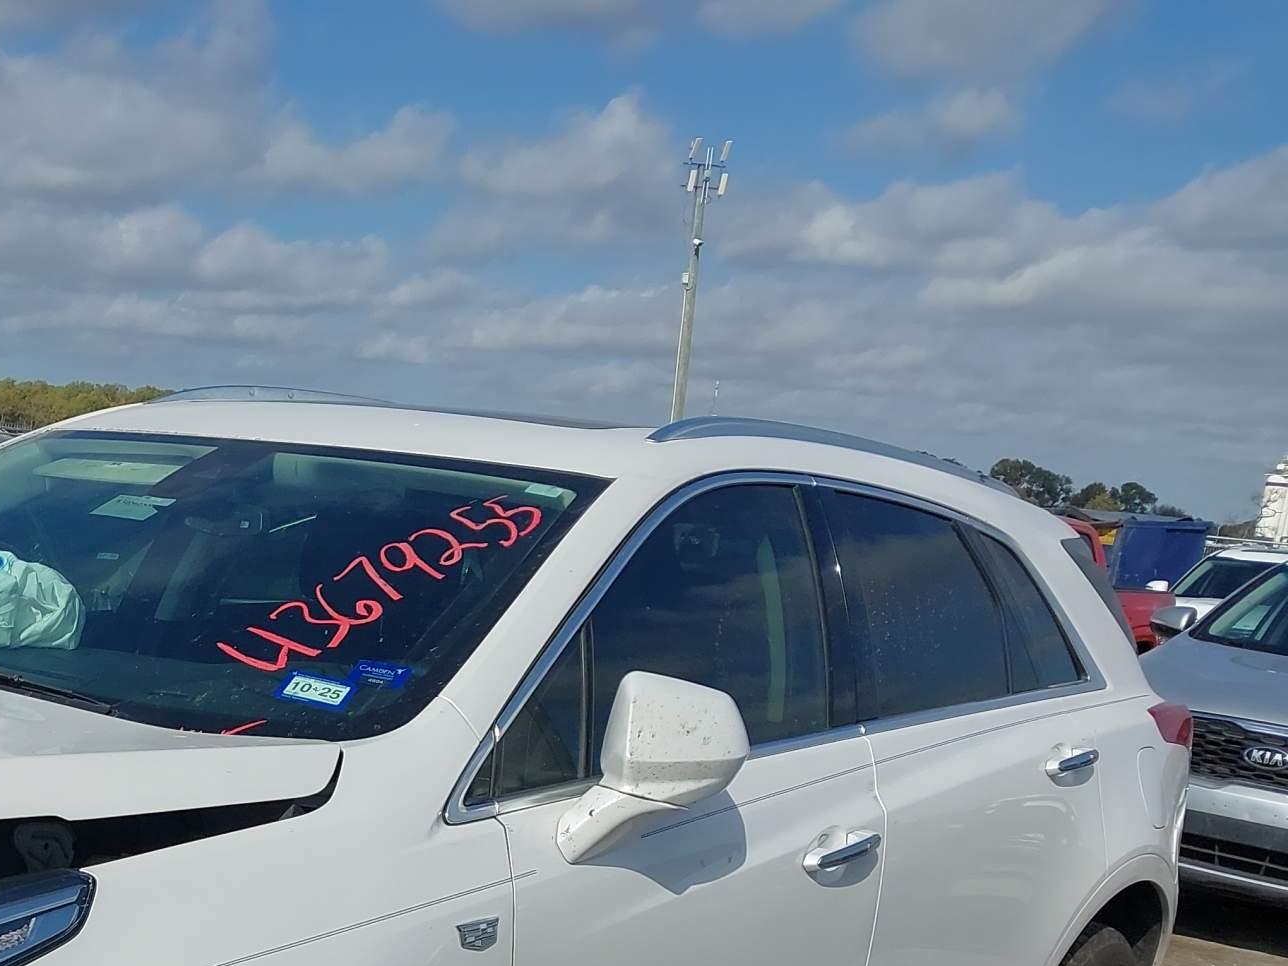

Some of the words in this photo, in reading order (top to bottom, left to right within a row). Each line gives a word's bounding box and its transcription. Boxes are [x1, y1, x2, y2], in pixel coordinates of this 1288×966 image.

[216, 496, 542, 673] 43679255
[359, 664, 395, 676] CAMDEN
[292, 681, 313, 693] 10
[317, 687, 343, 700] 25
[1250, 749, 1283, 767] KIA
